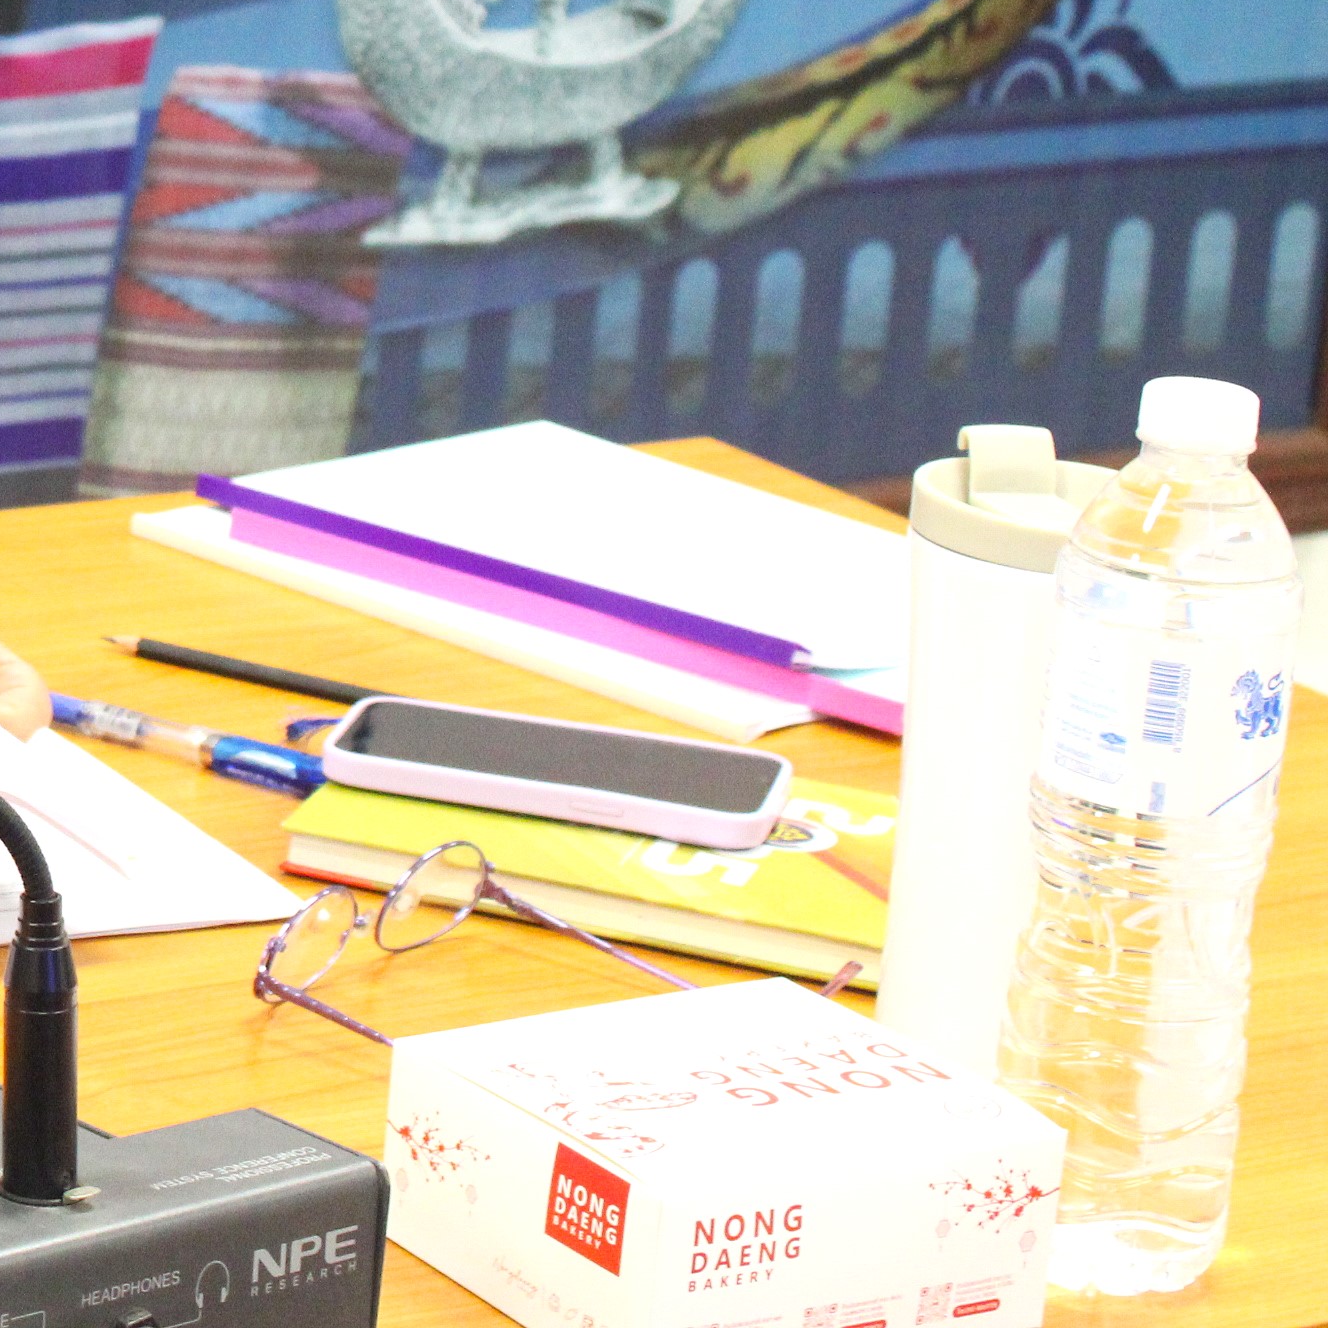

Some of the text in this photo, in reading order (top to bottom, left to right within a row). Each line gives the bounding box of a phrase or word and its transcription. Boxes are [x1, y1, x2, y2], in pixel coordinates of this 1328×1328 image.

[690, 1043, 909, 1086] DAENG
[725, 1061, 952, 1107] NONG
[149, 1146, 318, 1192] CONFERENCE SYSTEM
[214, 1152, 332, 1184] PROFESSIONAL
[554, 1195, 618, 1246] DAENG
[557, 1173, 621, 1227] NONG
[552, 1215, 602, 1250] BAKERY
[693, 1204, 803, 1247] NONG
[251, 1224, 359, 1284] NPE
[691, 1236, 801, 1275] DAENG
[81, 1269, 181, 1309] HEADPHONES
[250, 1260, 358, 1298] RESEARCH
[688, 1268, 774, 1293] BAKERY
